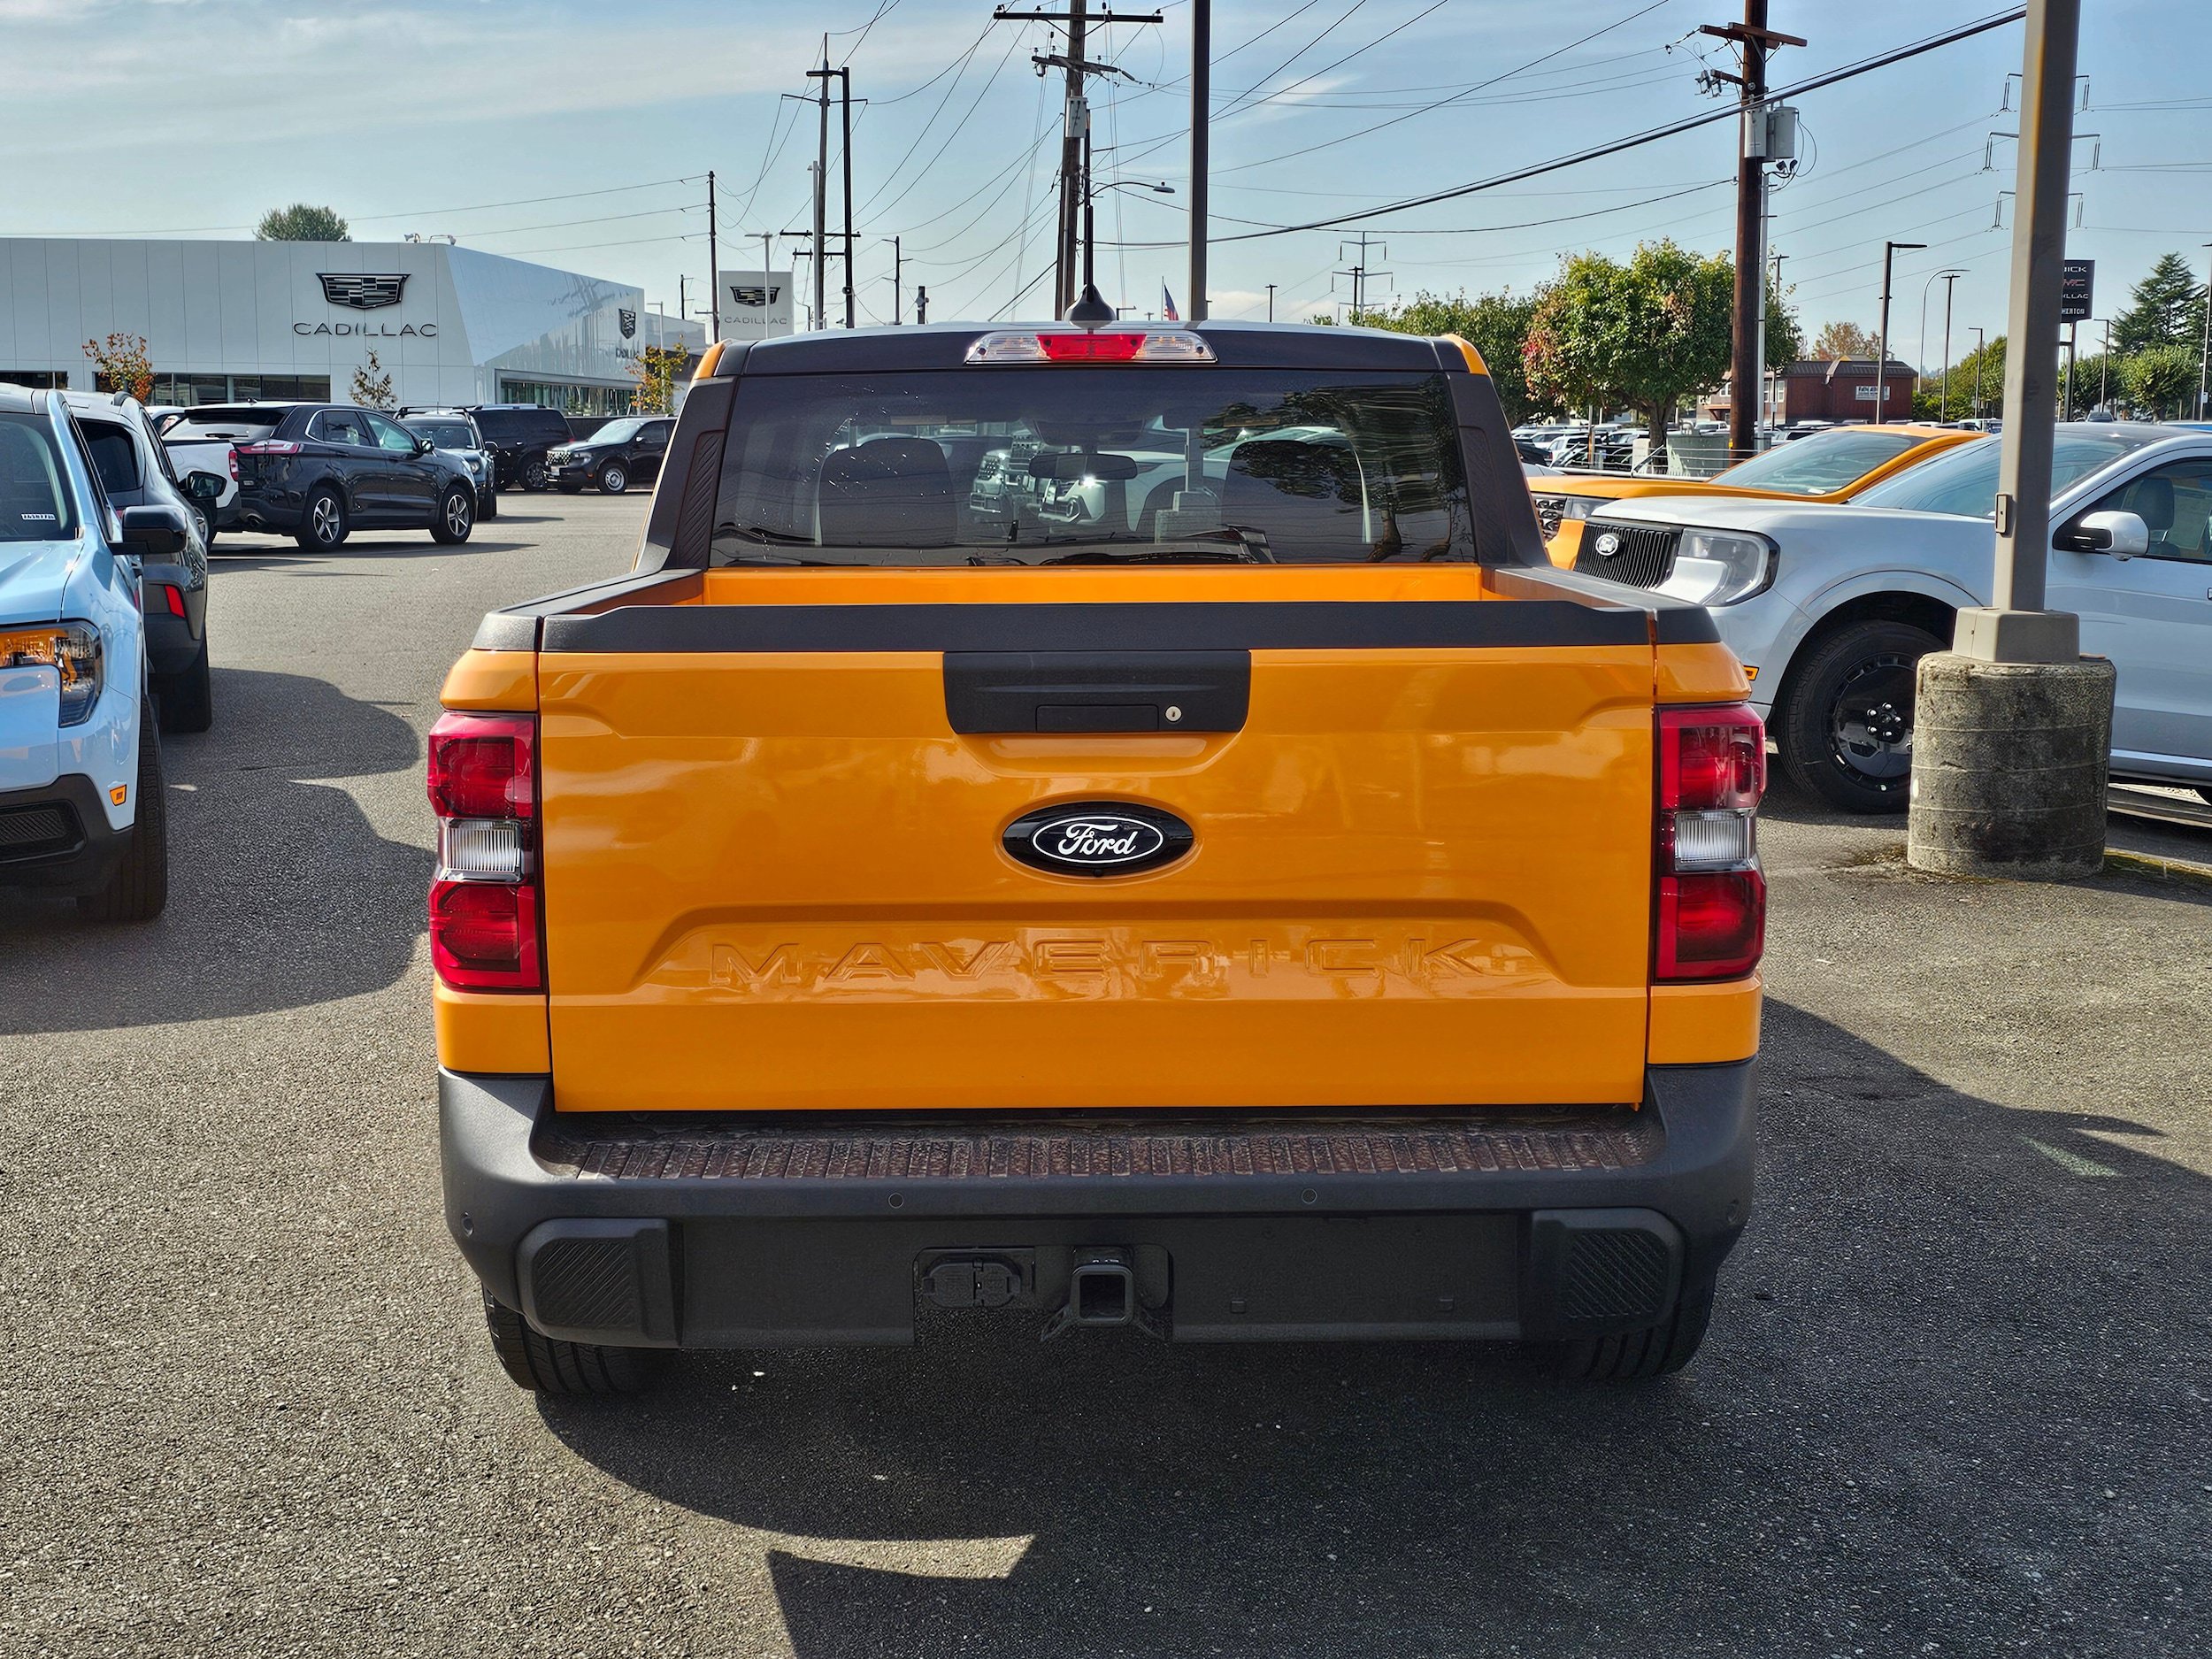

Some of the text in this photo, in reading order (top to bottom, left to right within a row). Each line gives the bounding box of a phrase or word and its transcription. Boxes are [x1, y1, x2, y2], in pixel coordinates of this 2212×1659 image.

[294, 322, 437, 337] CADILLAC
[1057, 822, 1139, 856] Ford
[710, 938, 1486, 985] MAVERICK
